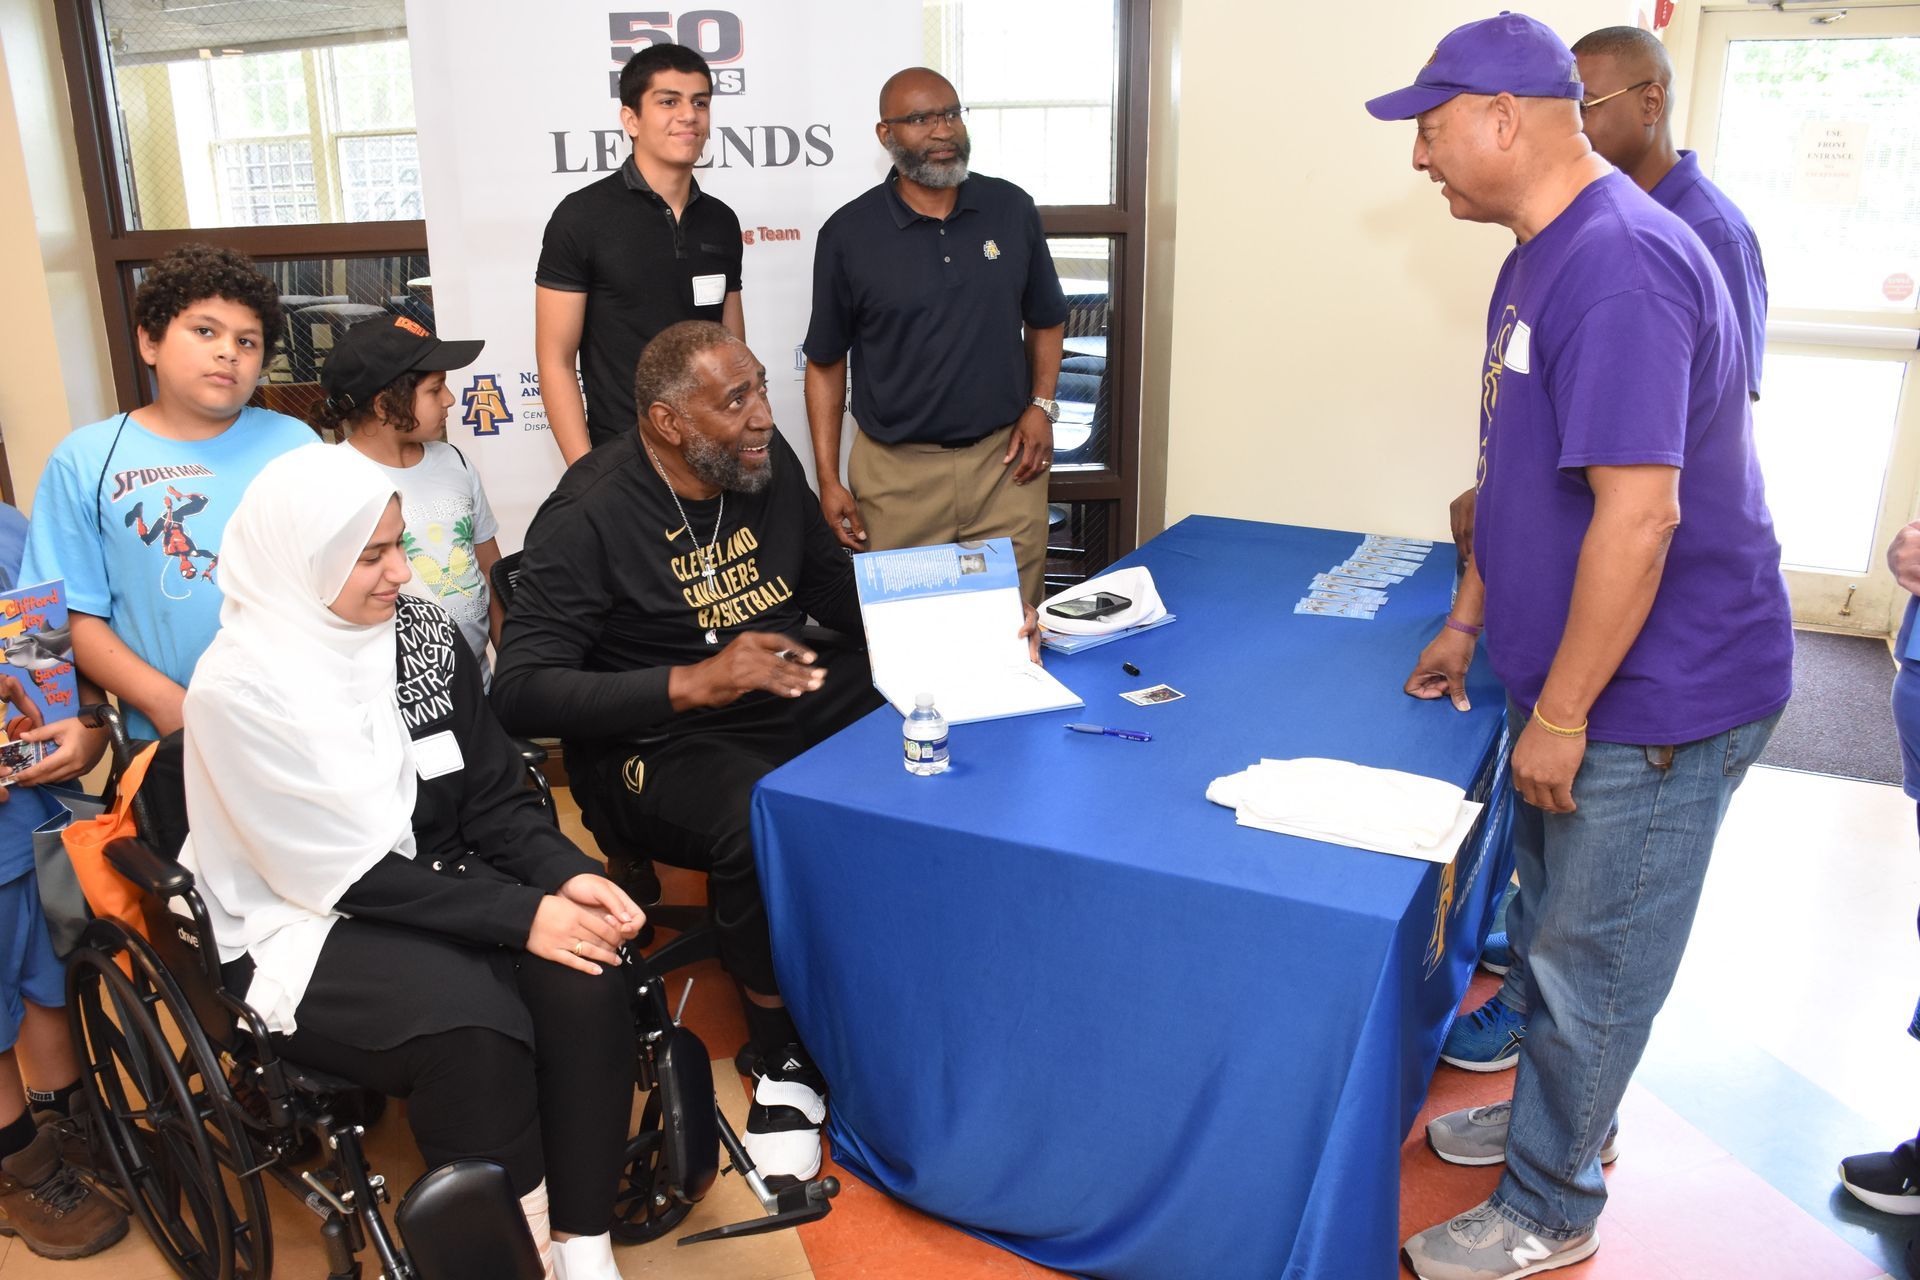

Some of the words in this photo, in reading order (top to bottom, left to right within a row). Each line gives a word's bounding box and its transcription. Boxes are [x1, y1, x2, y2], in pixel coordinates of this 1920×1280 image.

[756, 226, 801, 242] Team
[670, 526, 759, 582] CLEVELAND
[5, 588, 60, 618] Clifford
[697, 575, 793, 629] BASKETBALL
[21, 613, 46, 631] Ray
[34, 661, 73, 684] Saves
[46, 688, 74, 707] Day
